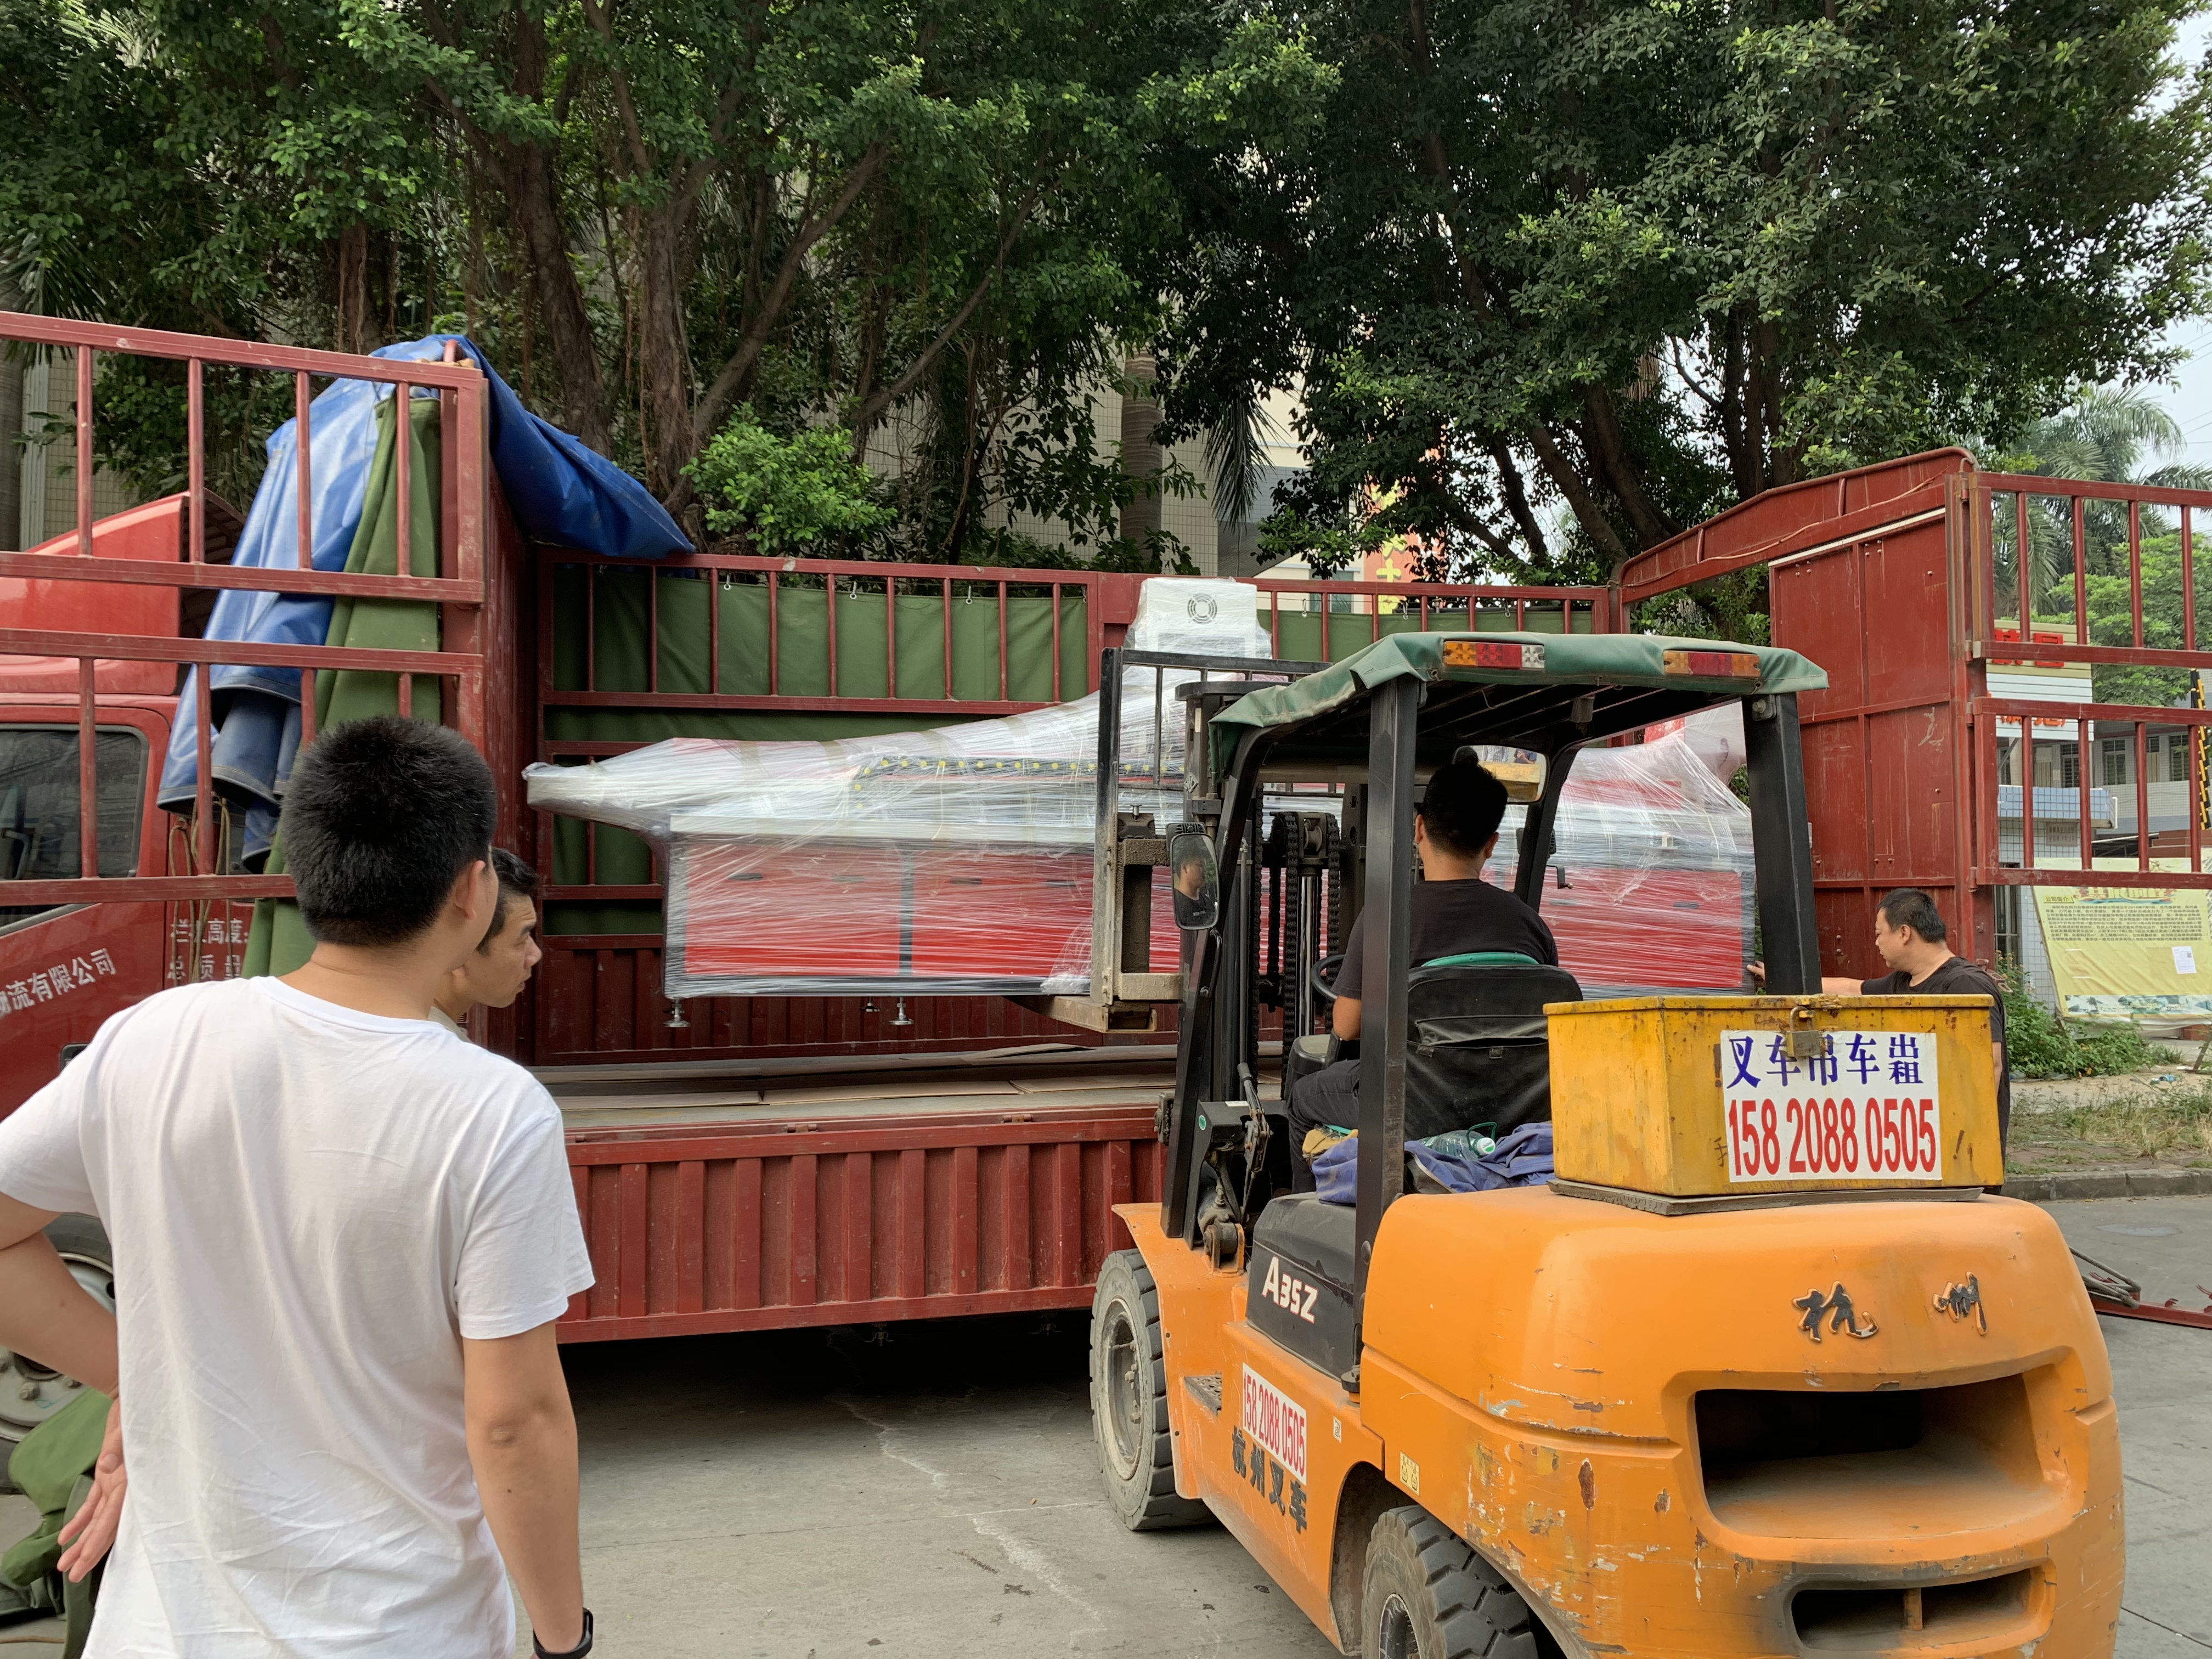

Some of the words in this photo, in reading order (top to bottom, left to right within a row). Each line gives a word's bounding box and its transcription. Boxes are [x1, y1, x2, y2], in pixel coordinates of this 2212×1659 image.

[1729, 1098, 1780, 1176] 158
[1786, 1098, 1859, 1173] 2088
[1865, 1097, 1936, 1173] 0505
[1243, 1371, 1257, 1436] 158
[1259, 1384, 1280, 1455] 2088
[1282, 1402, 1305, 1477] 0505
[1232, 1425, 1307, 1534] 杭州叉车
